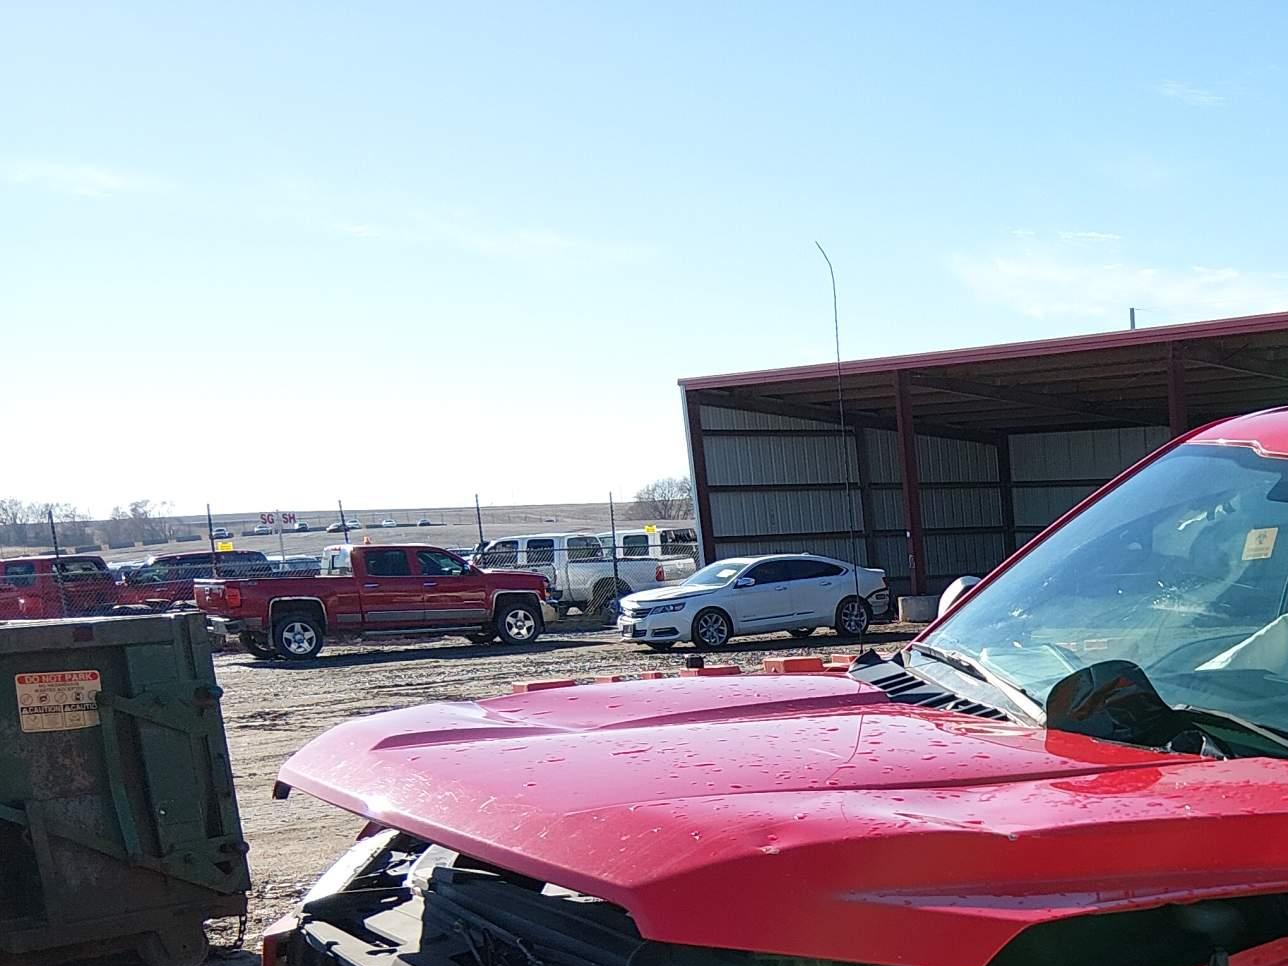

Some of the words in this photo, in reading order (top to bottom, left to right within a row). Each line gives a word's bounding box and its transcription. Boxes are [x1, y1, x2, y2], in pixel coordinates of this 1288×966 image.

[260, 513, 274, 524] SG
[281, 513, 296, 524] SH
[24, 676, 40, 684] DO
[42, 675, 62, 683] NOT
[64, 673, 93, 682] PARK
[28, 706, 62, 714] CAUTION
[70, 703, 97, 711] CAUTIO
